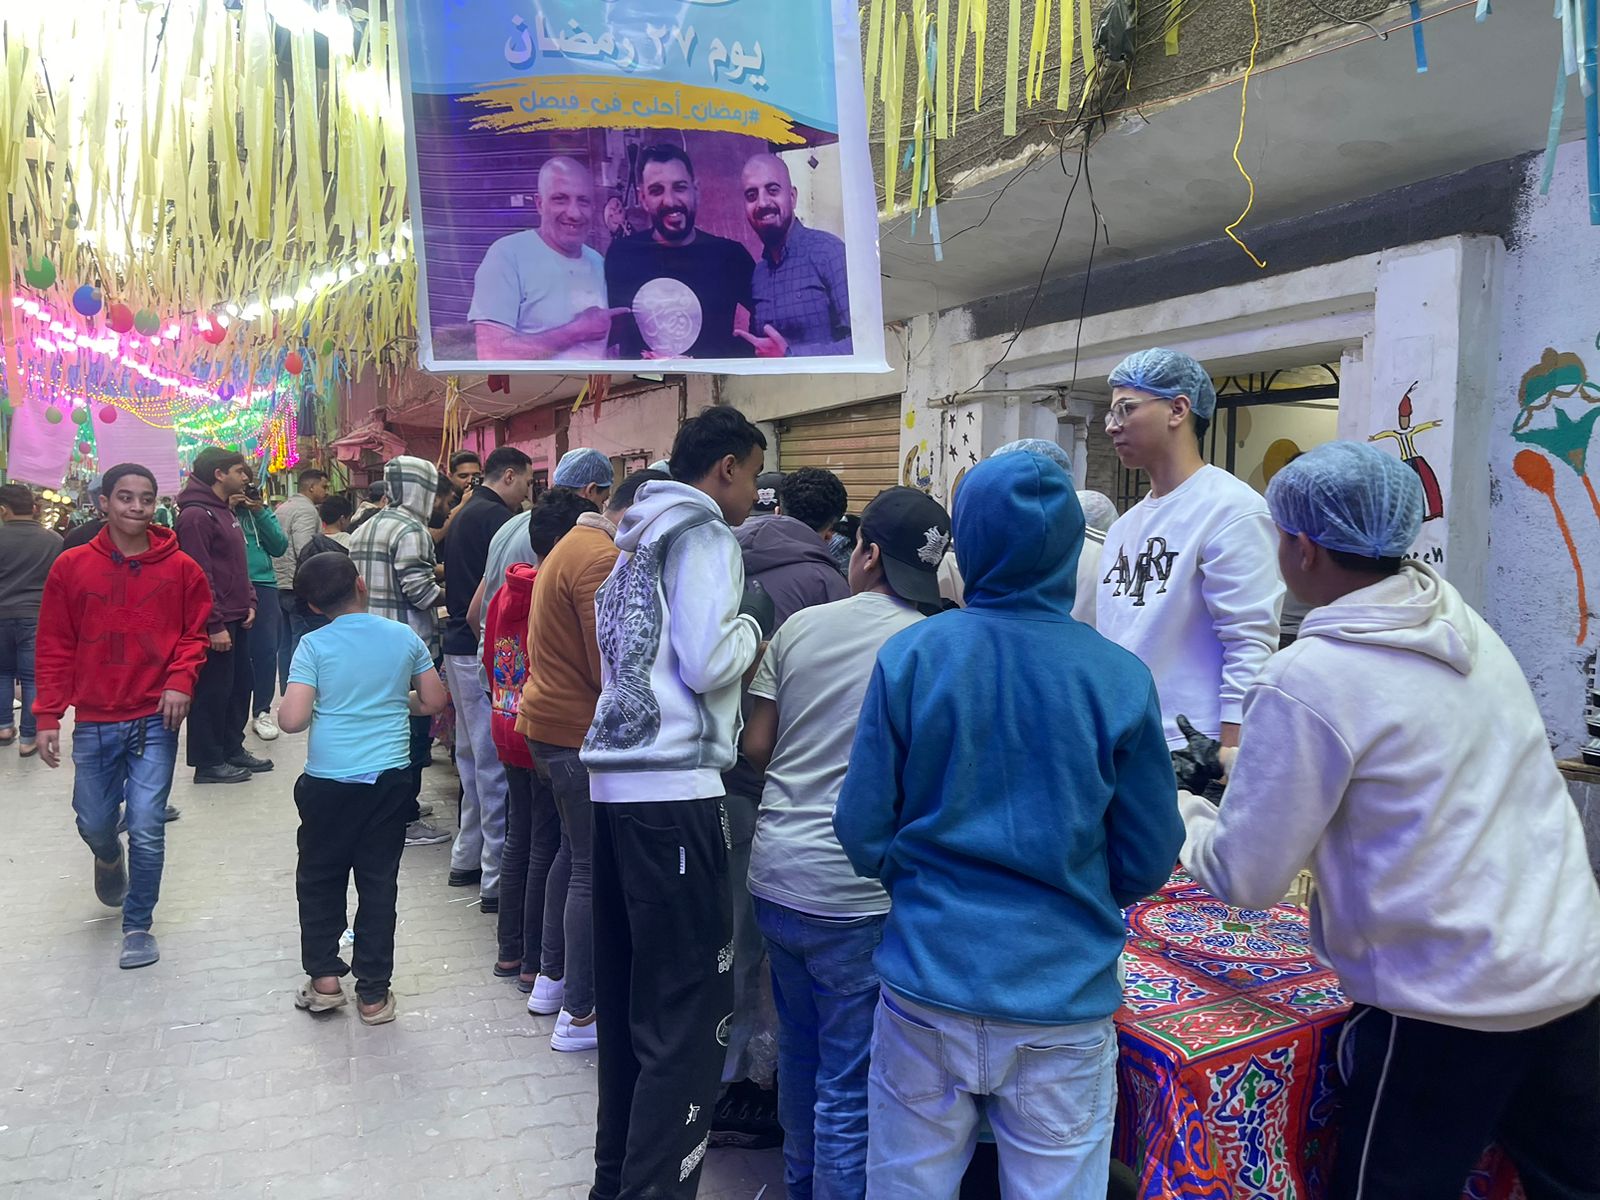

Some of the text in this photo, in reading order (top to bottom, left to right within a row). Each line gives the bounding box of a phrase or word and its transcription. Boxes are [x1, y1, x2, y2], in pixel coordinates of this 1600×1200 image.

[504, 13, 767, 86] يوم ٢٧ رمضان
